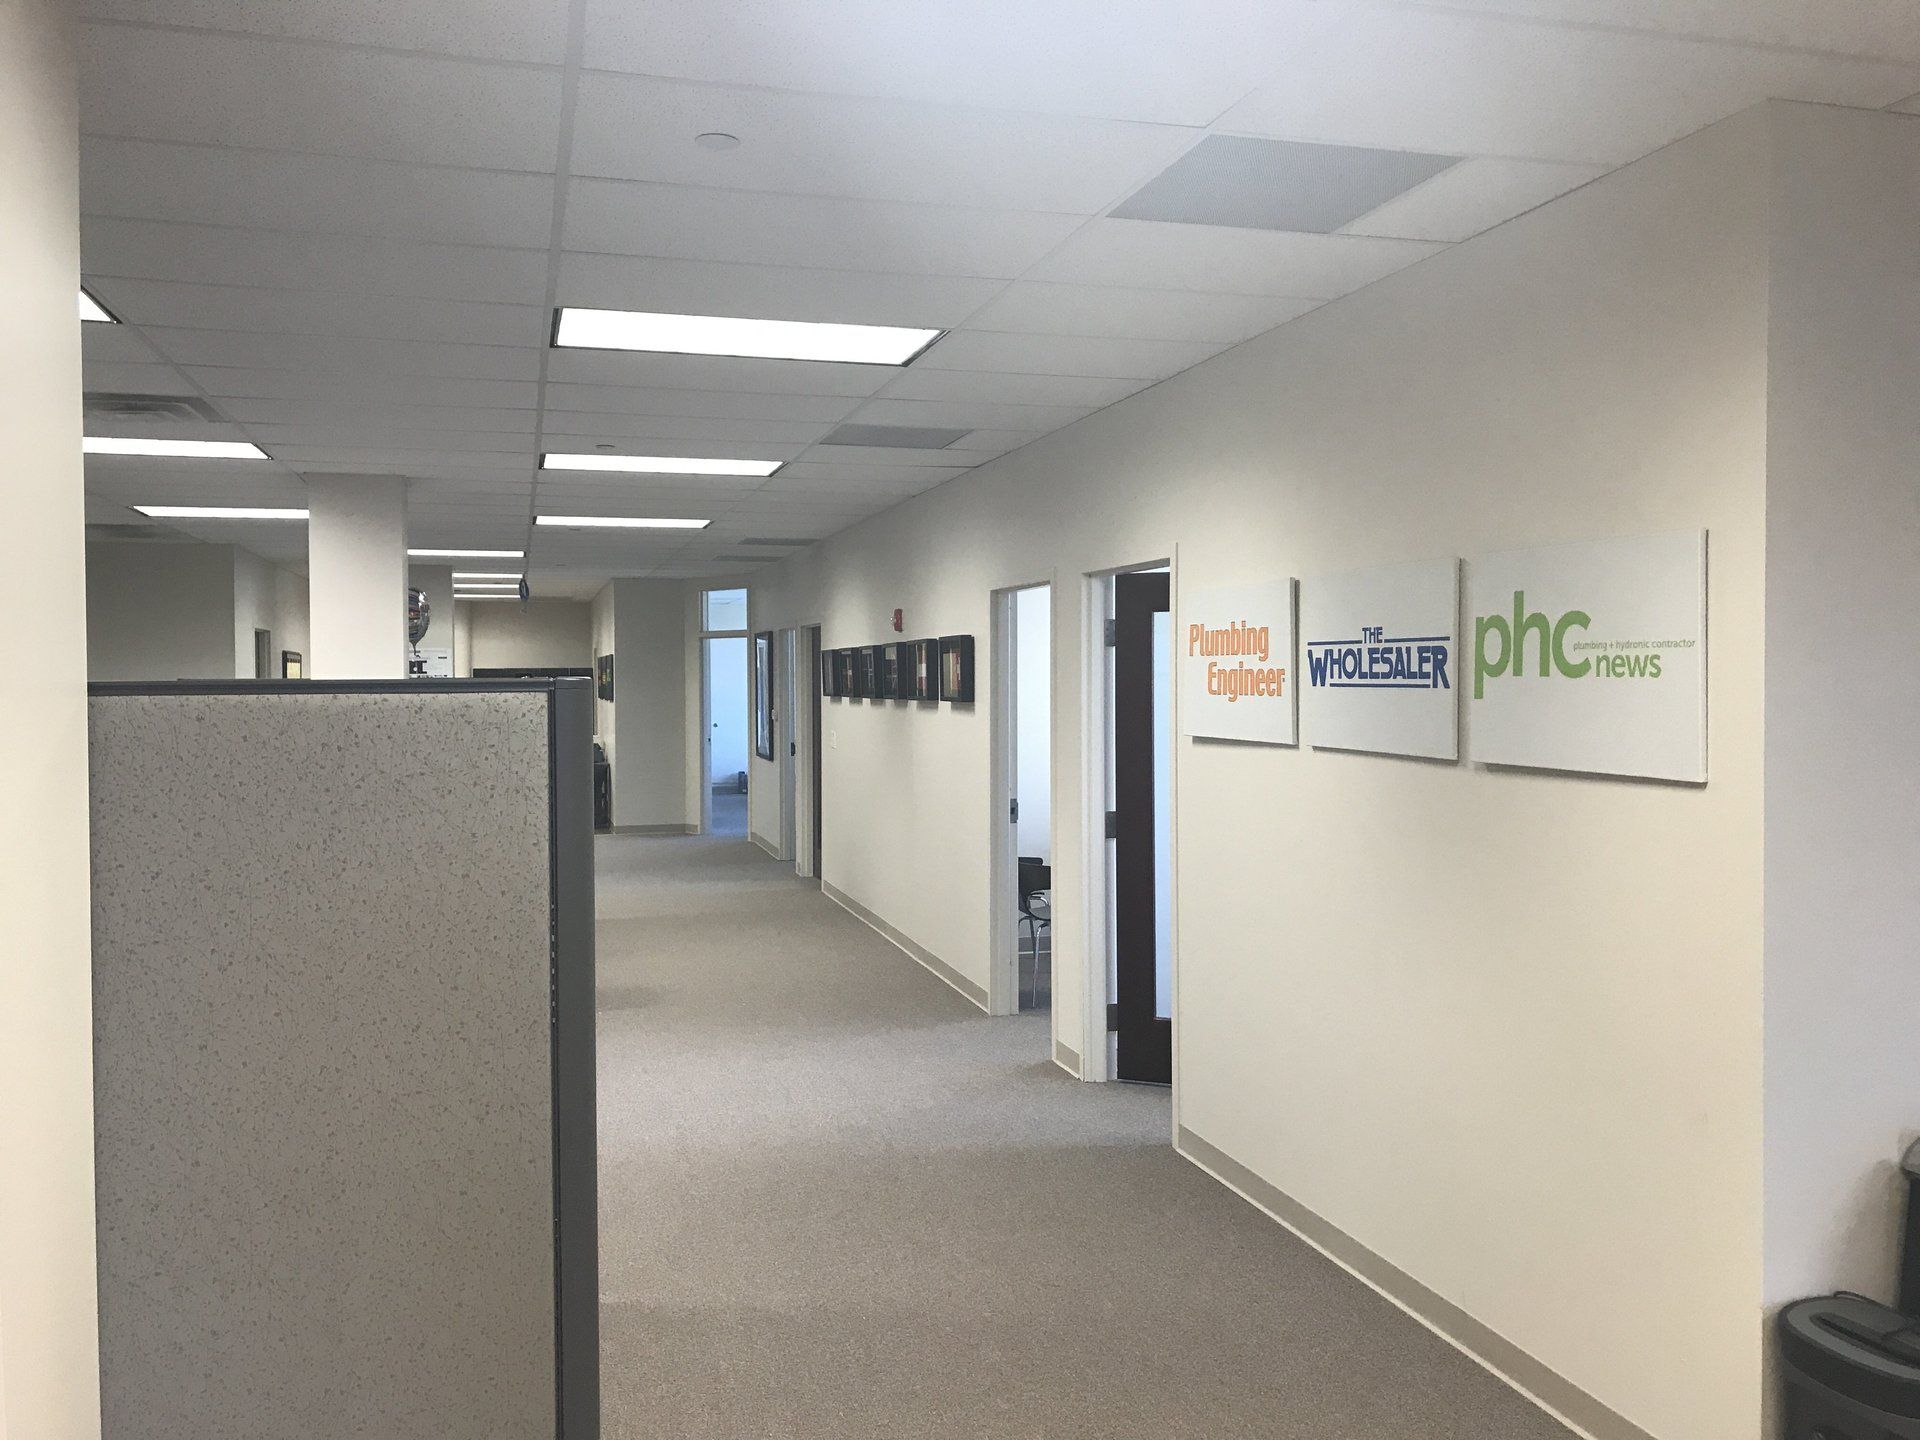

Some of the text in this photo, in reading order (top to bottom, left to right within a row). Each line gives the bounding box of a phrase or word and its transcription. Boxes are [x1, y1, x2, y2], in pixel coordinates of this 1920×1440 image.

[1189, 620, 1269, 661] Plumbing
[1361, 626, 1383, 644] THE
[1474, 590, 1592, 700] phc
[1573, 640, 1608, 652] plumbing
[1615, 639, 1650, 651] hydronic
[1651, 639, 1696, 649] contractor
[1207, 661, 1286, 703] Engineer
[1307, 645, 1451, 689] WHOLESALER
[1595, 654, 1662, 679] news
